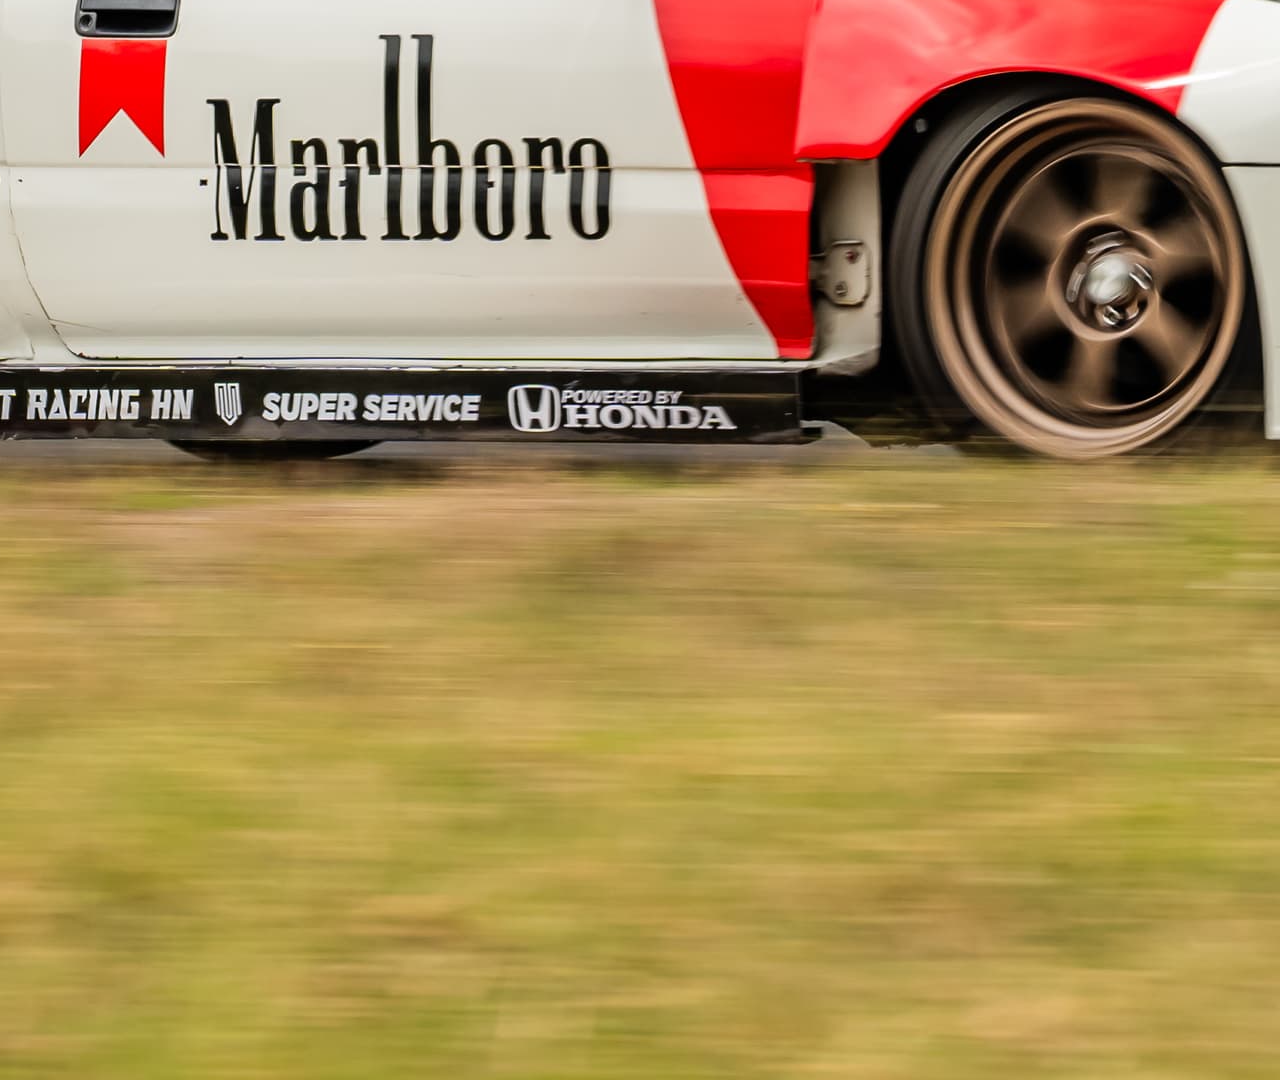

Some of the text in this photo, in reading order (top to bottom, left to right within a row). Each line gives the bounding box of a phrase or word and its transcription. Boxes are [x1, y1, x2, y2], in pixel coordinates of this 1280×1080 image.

[206, 34, 613, 241] Marlboro
[26, 388, 142, 421] RACING
[151, 389, 195, 421] HN
[261, 391, 482, 422] SUPER SERVICE
[560, 390, 684, 405] POWERED BY
[562, 404, 738, 430] HONDA
